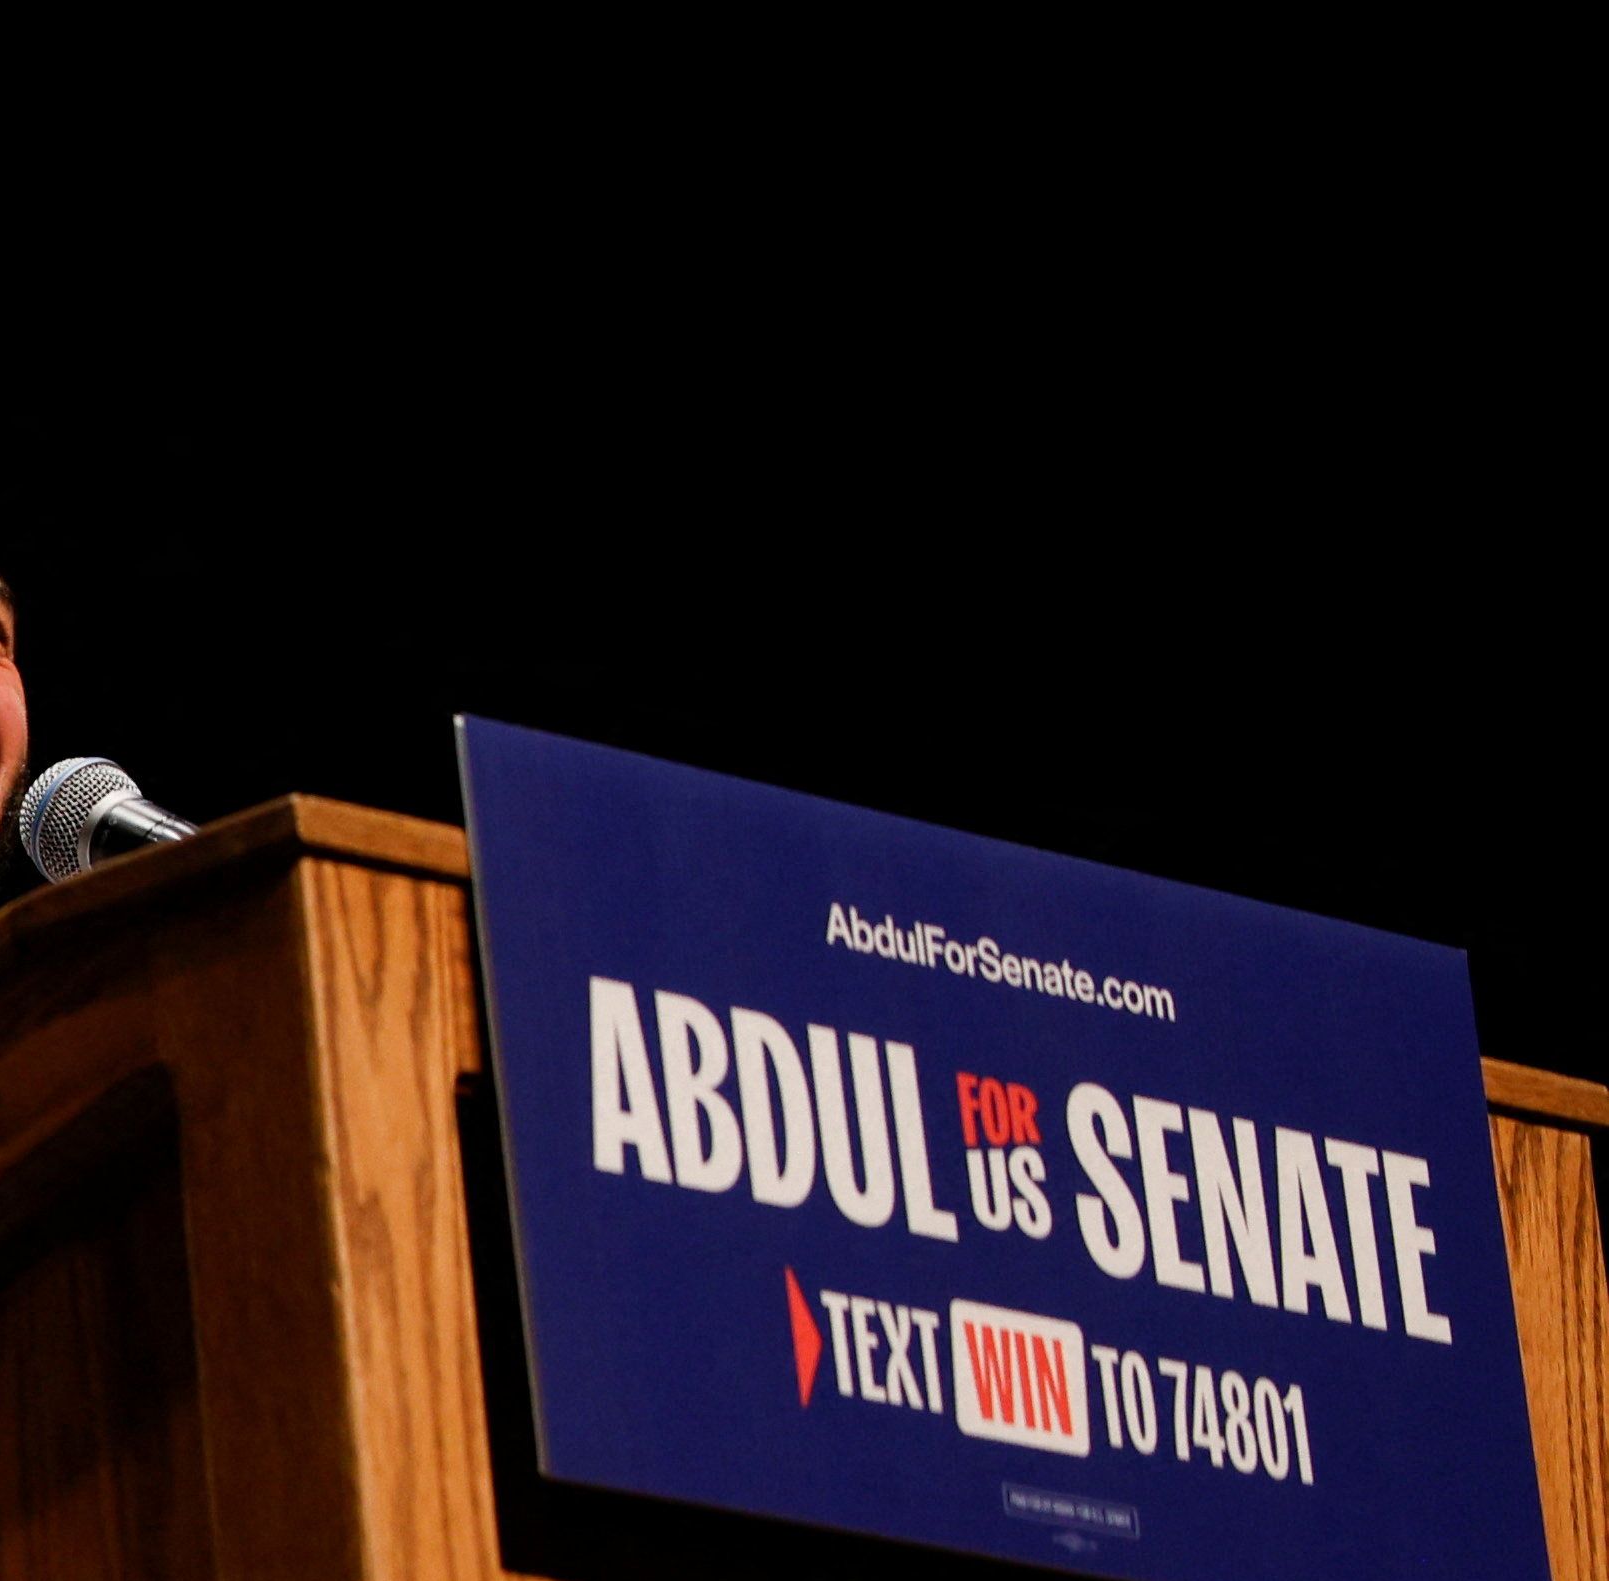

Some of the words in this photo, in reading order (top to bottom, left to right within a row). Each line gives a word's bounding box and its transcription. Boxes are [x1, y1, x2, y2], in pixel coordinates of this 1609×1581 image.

[826, 902, 1176, 1023] AbdulForSenate.com
[589, 975, 960, 1243] ABDUL
[956, 1071, 1042, 1147] FOR
[967, 1145, 1053, 1240] US
[1066, 1082, 1453, 1345] SENATE
[820, 1289, 944, 1415] TEXT
[964, 1321, 1074, 1438] WIN
[1090, 1344, 1159, 1456] TO
[1159, 1360, 1314, 1486] 74801
